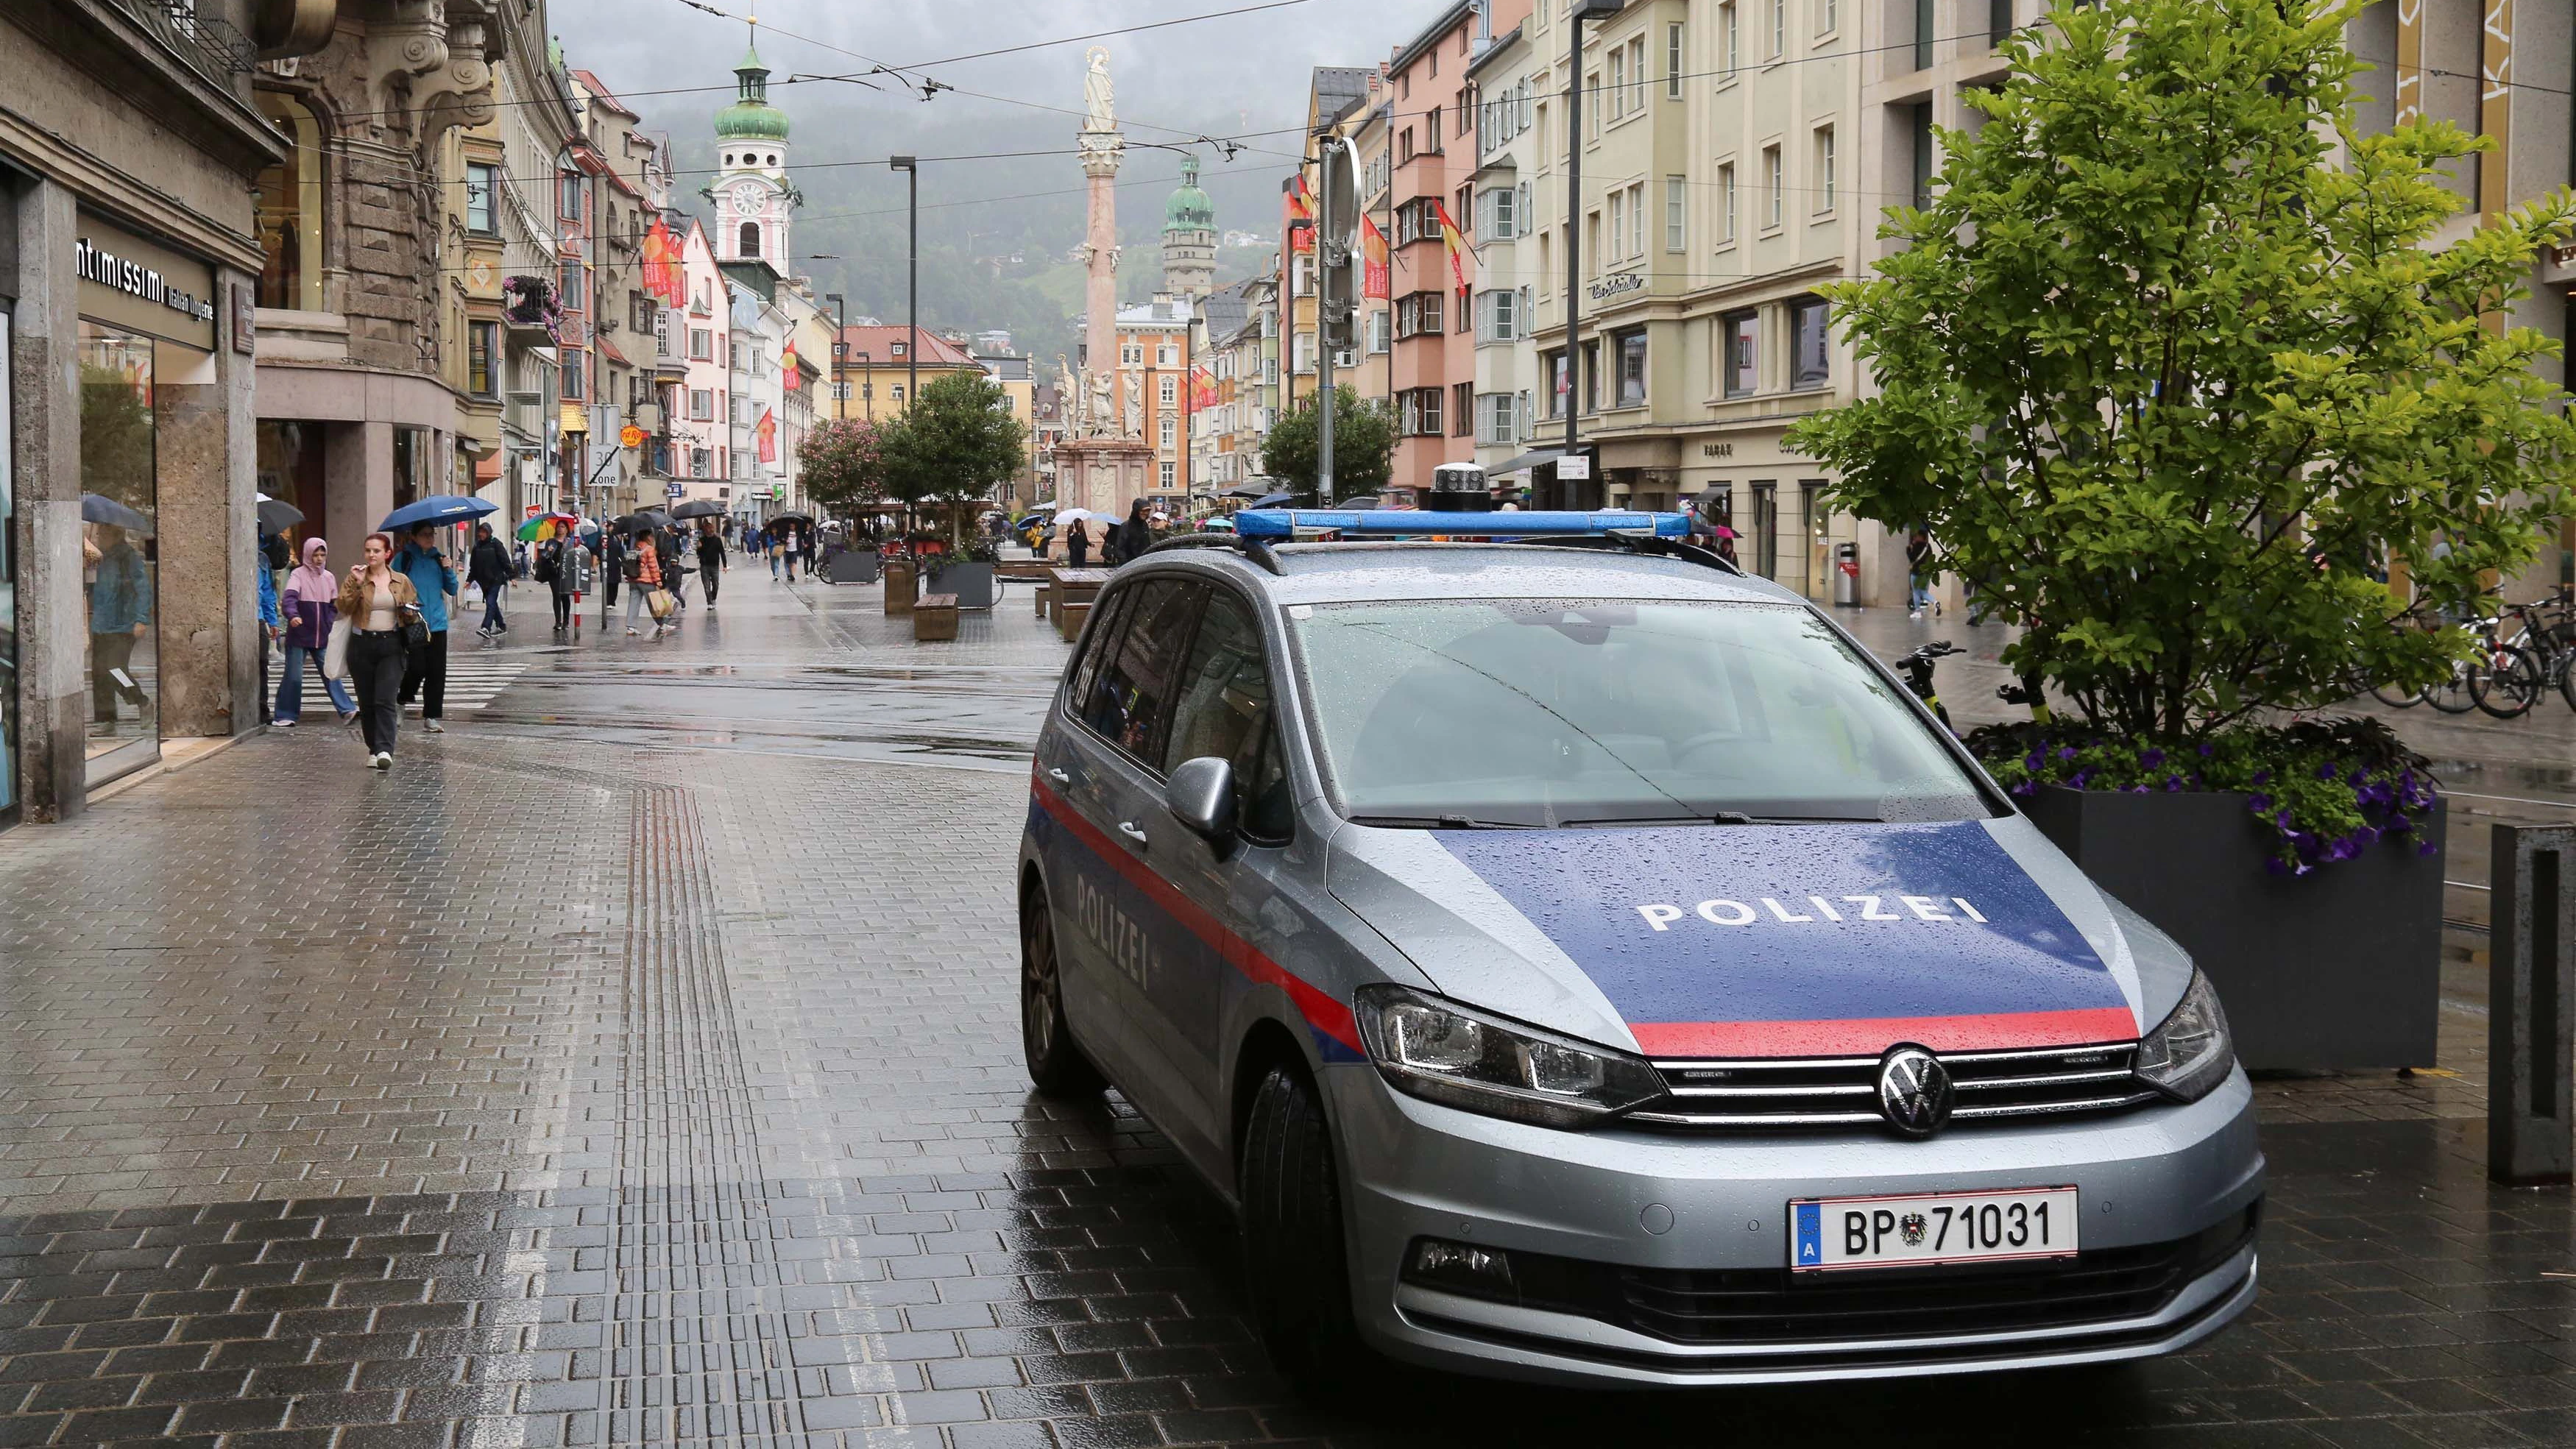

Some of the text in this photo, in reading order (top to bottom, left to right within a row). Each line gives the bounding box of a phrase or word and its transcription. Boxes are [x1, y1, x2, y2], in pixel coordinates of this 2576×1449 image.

[76, 238, 164, 304] ntimissimi
[168, 285, 188, 313] Italian
[189, 294, 214, 322] lingerie
[595, 451, 612, 467] 30
[1078, 874, 1148, 991] POLIZEI
[1636, 895, 1989, 932] POLIZEI
[1802, 1242, 1816, 1258] A
[1844, 1200, 2049, 1255] BP 71031
